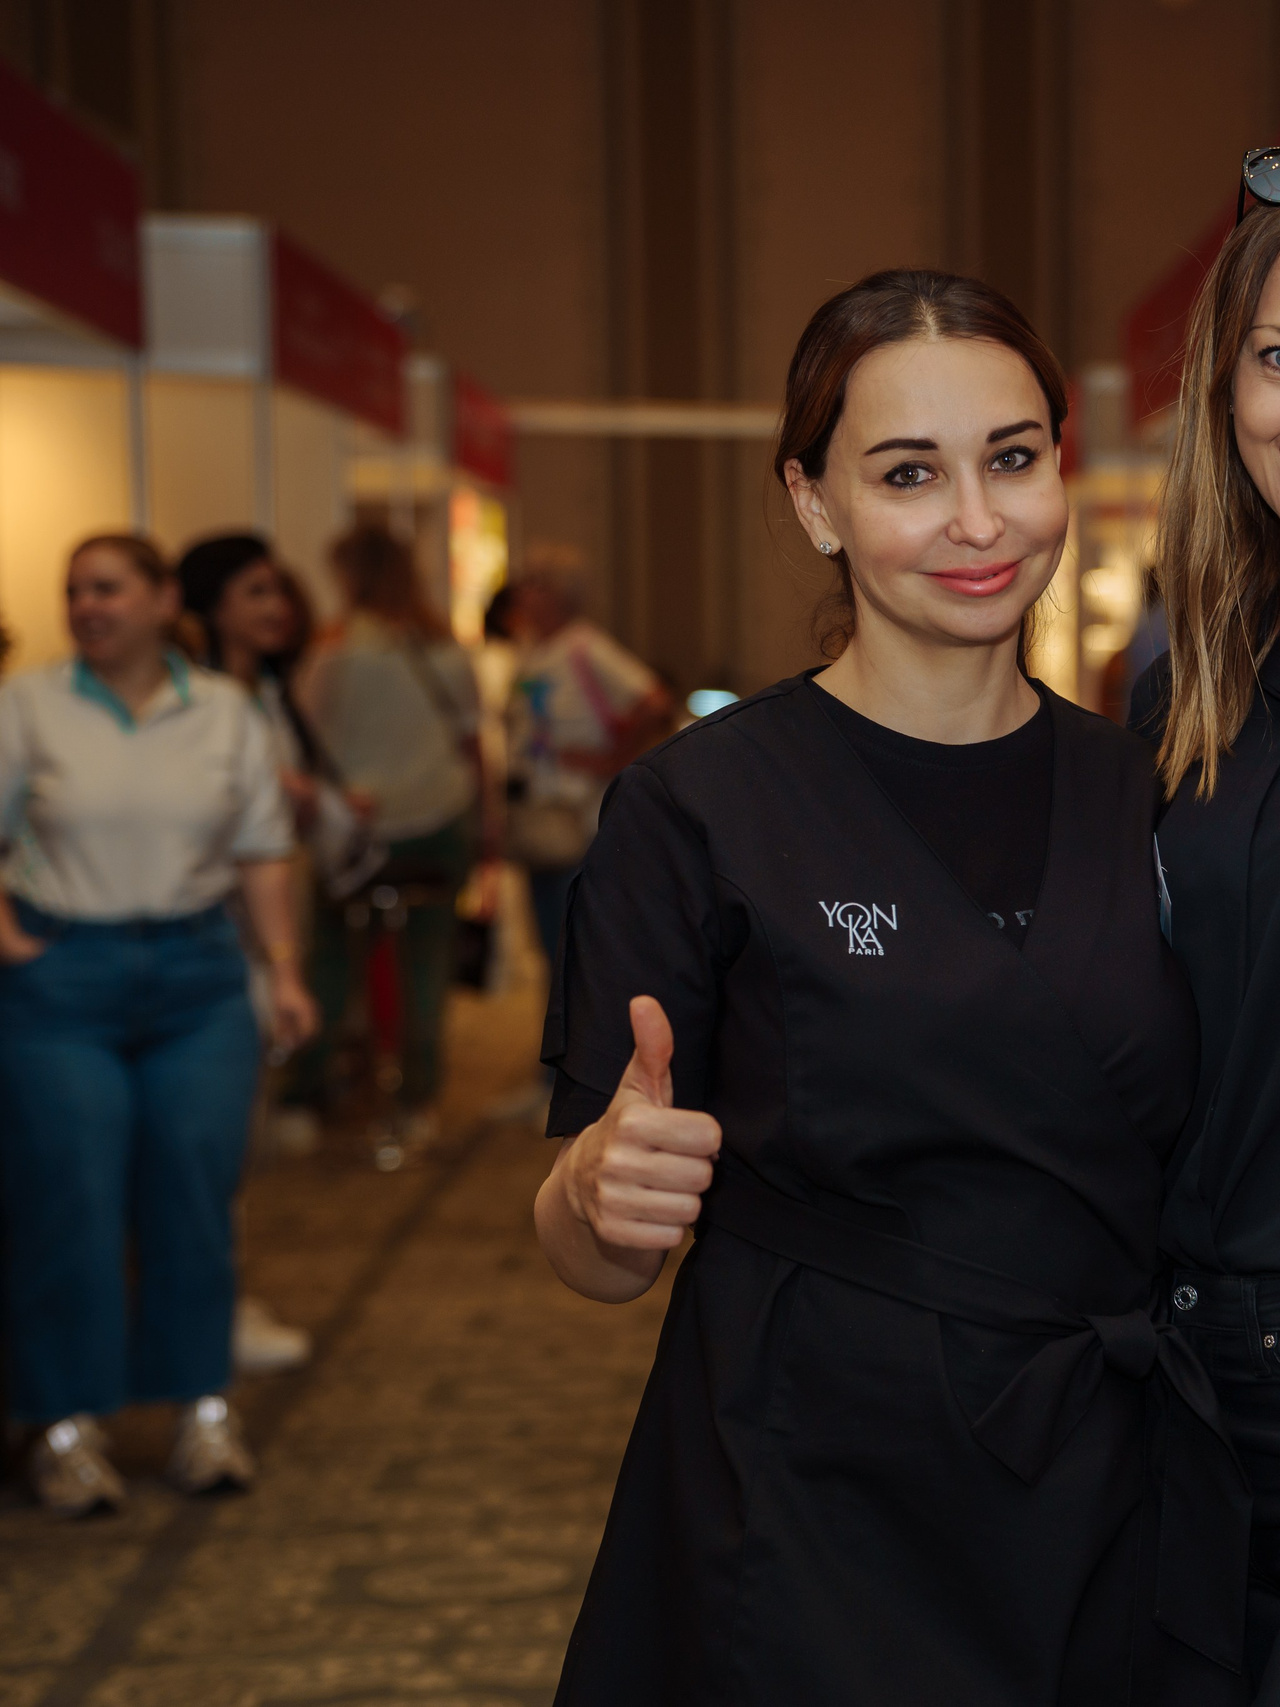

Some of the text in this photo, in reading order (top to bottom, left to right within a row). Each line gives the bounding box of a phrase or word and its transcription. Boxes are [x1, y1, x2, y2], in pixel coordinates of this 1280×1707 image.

[818, 900, 898, 931] YON
[848, 913, 883, 949] KA
[848, 947, 885, 956] PARIS
